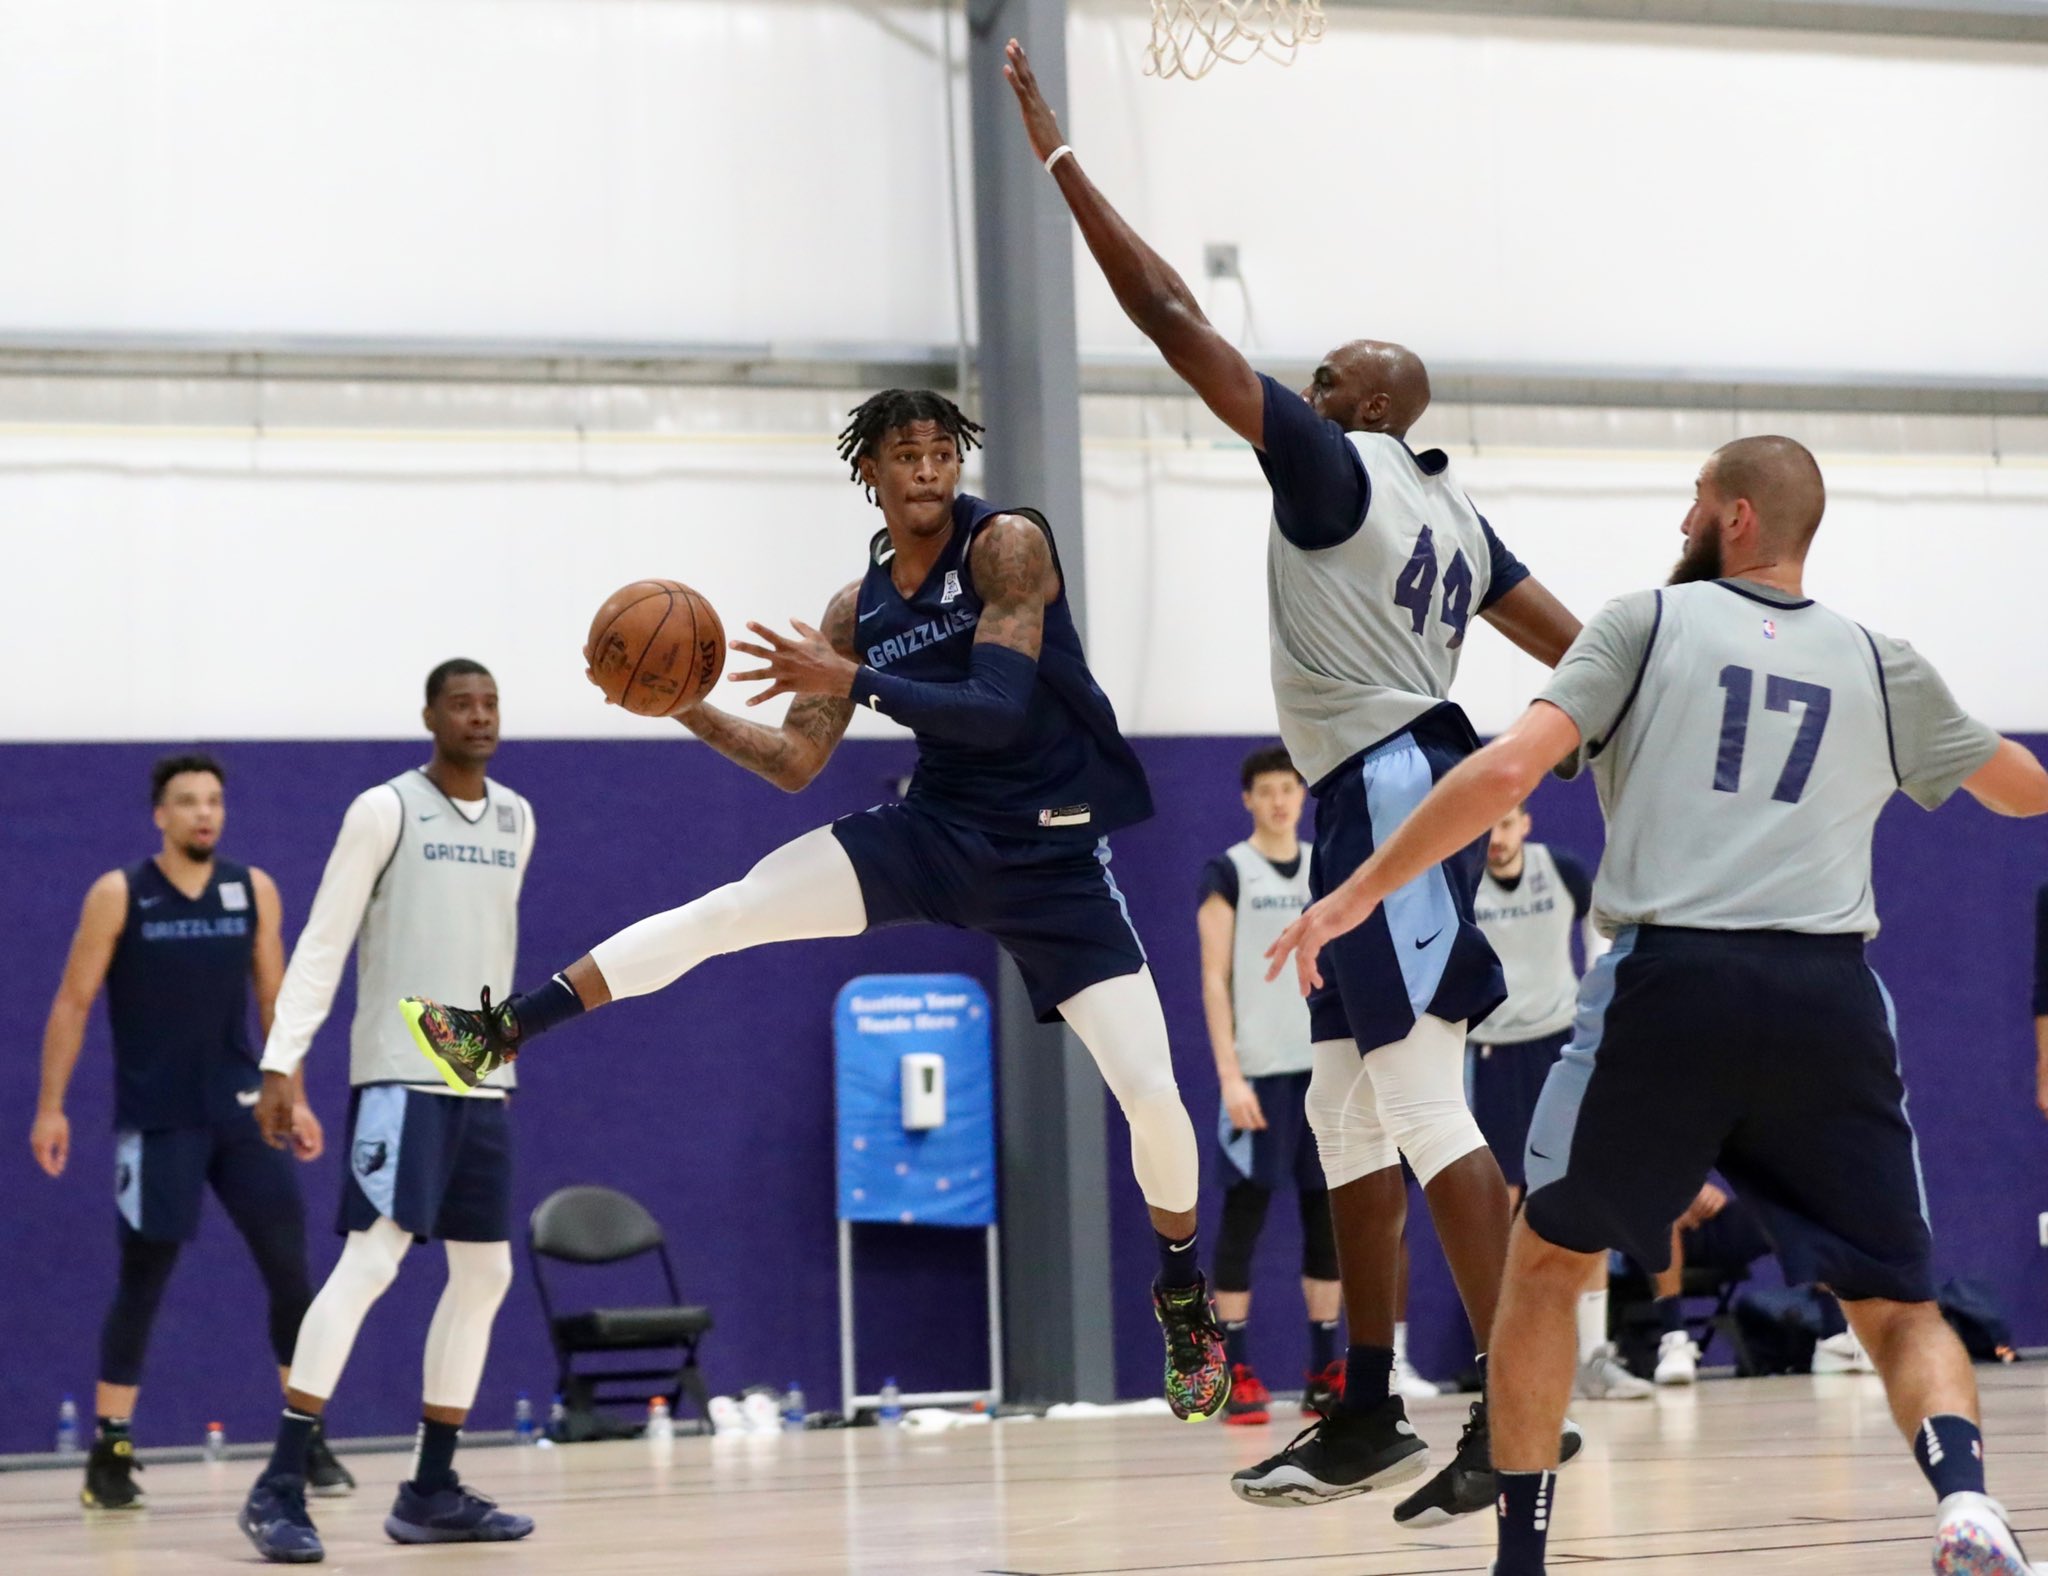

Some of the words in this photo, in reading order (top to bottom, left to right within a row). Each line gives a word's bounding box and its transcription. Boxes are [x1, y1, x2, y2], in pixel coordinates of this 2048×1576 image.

[1394, 524, 1473, 650] 44
[867, 608, 978, 668] GRIZZLIES
[1713, 664, 1832, 804] 17
[423, 843, 516, 868] GRIZZLIES
